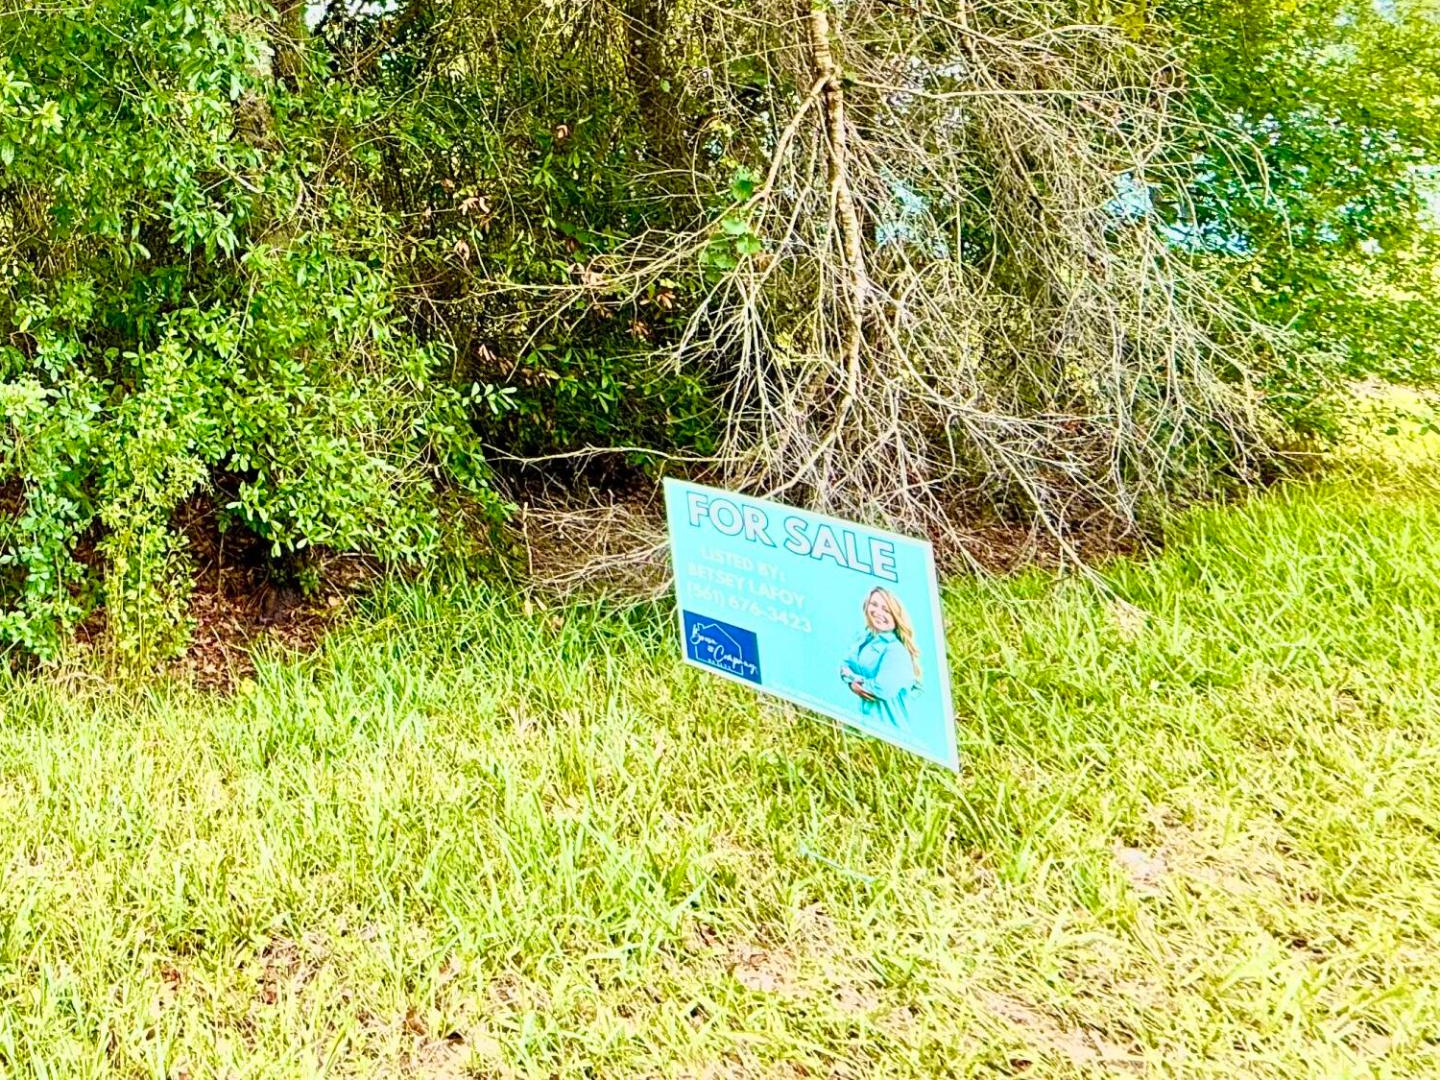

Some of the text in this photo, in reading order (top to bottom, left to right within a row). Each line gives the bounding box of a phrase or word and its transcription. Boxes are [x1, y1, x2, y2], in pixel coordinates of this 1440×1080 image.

[686, 491, 898, 583] FOR SALE
[700, 545, 753, 571] LISTED
